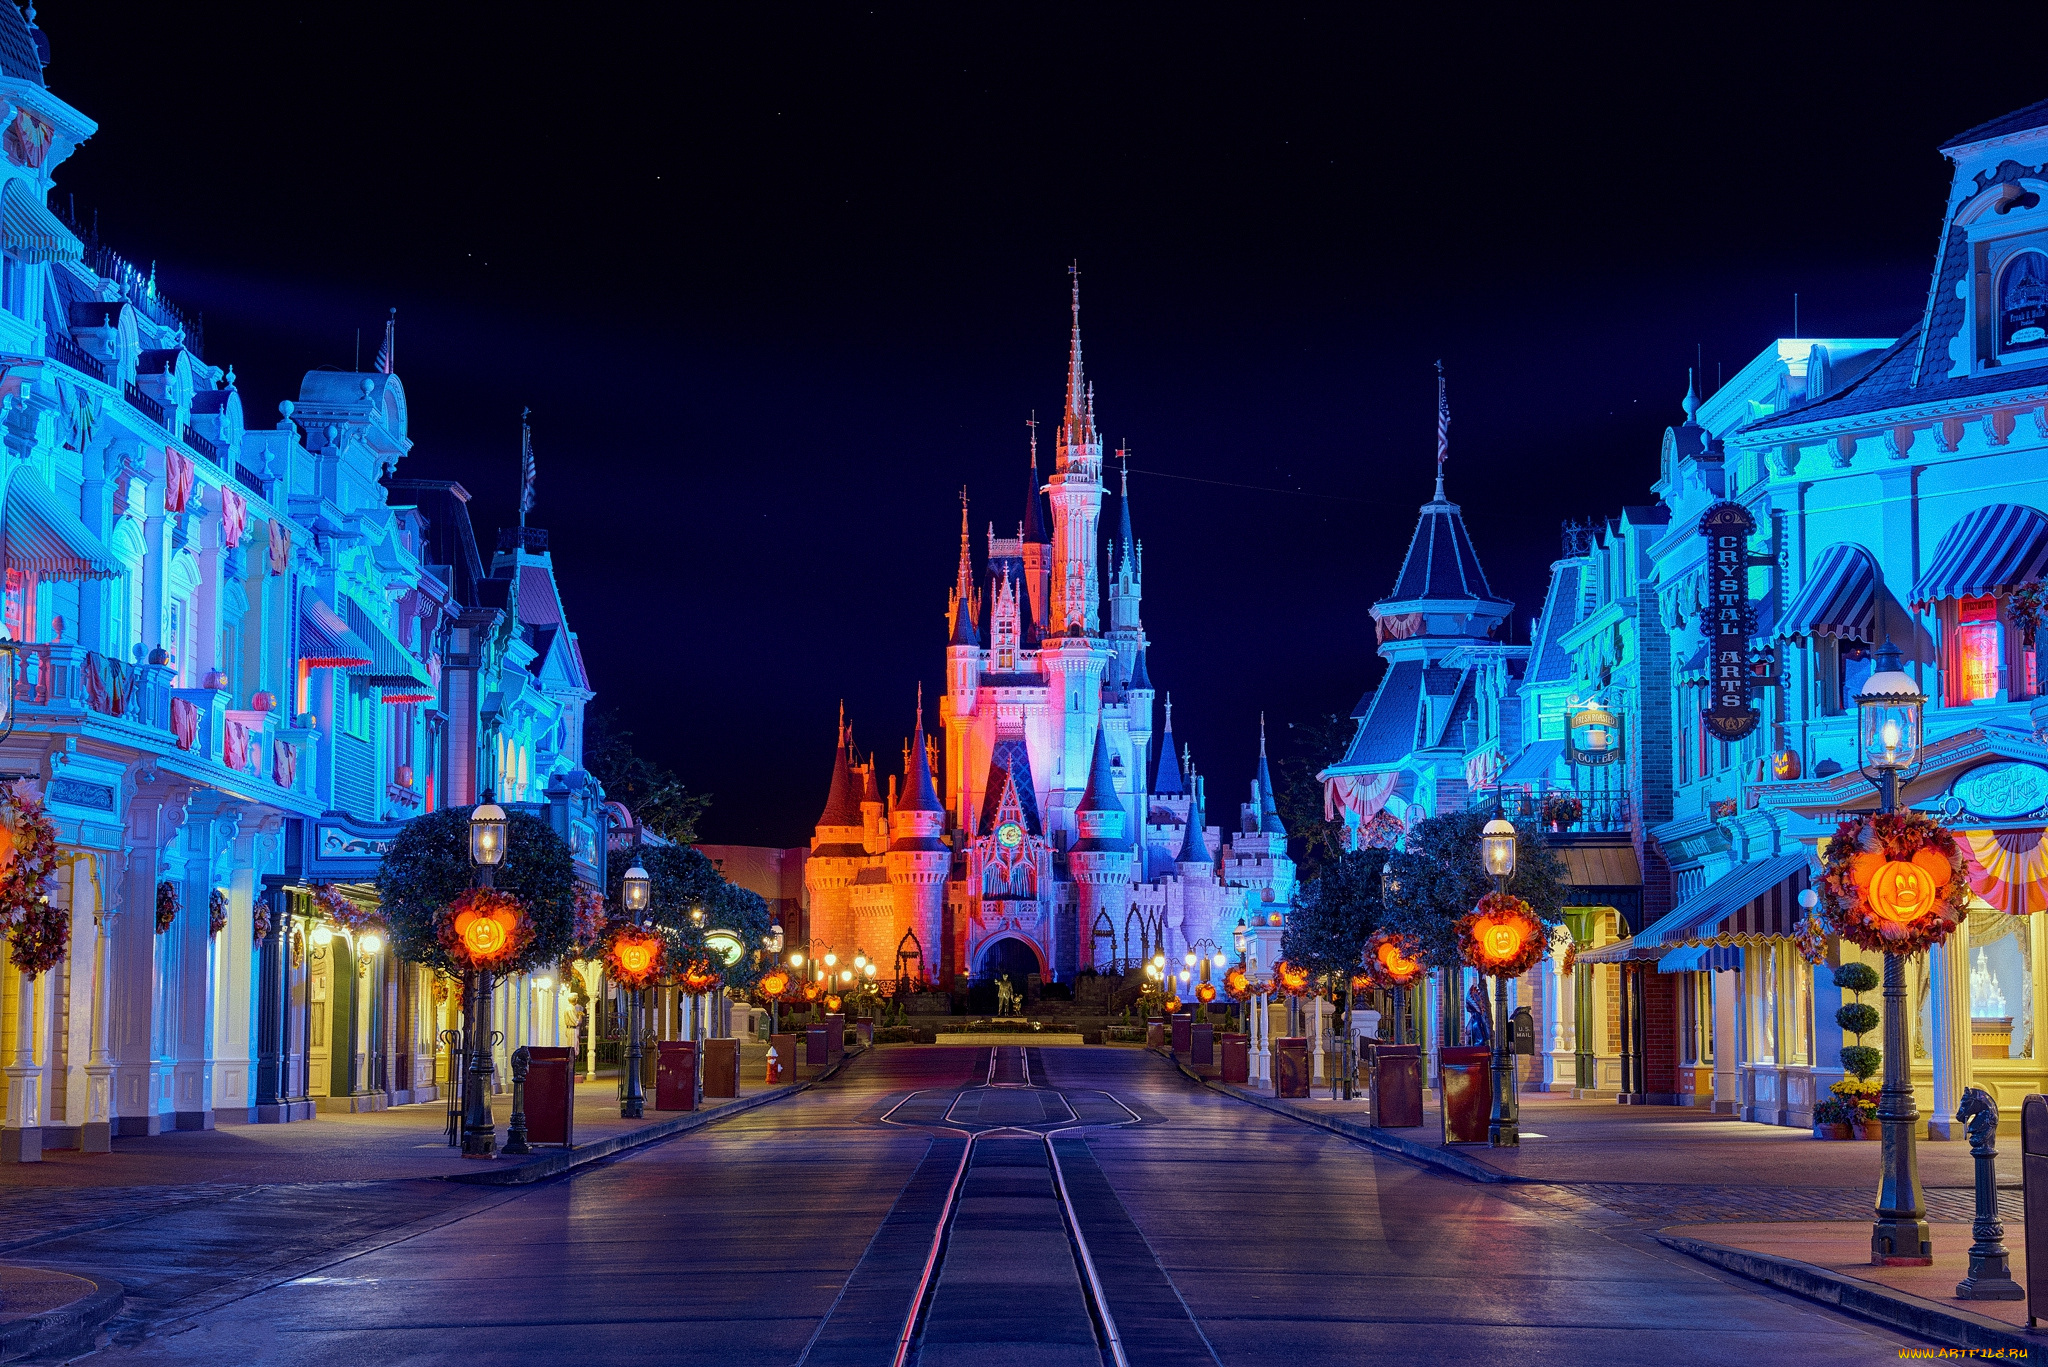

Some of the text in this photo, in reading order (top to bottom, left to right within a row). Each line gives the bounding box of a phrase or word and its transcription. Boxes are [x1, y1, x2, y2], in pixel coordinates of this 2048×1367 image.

[1718, 536, 1742, 707] CRYSTAL ARTS
[1575, 713, 1615, 725] FRESH ROASTED
[1577, 753, 1614, 764] COFFEE
